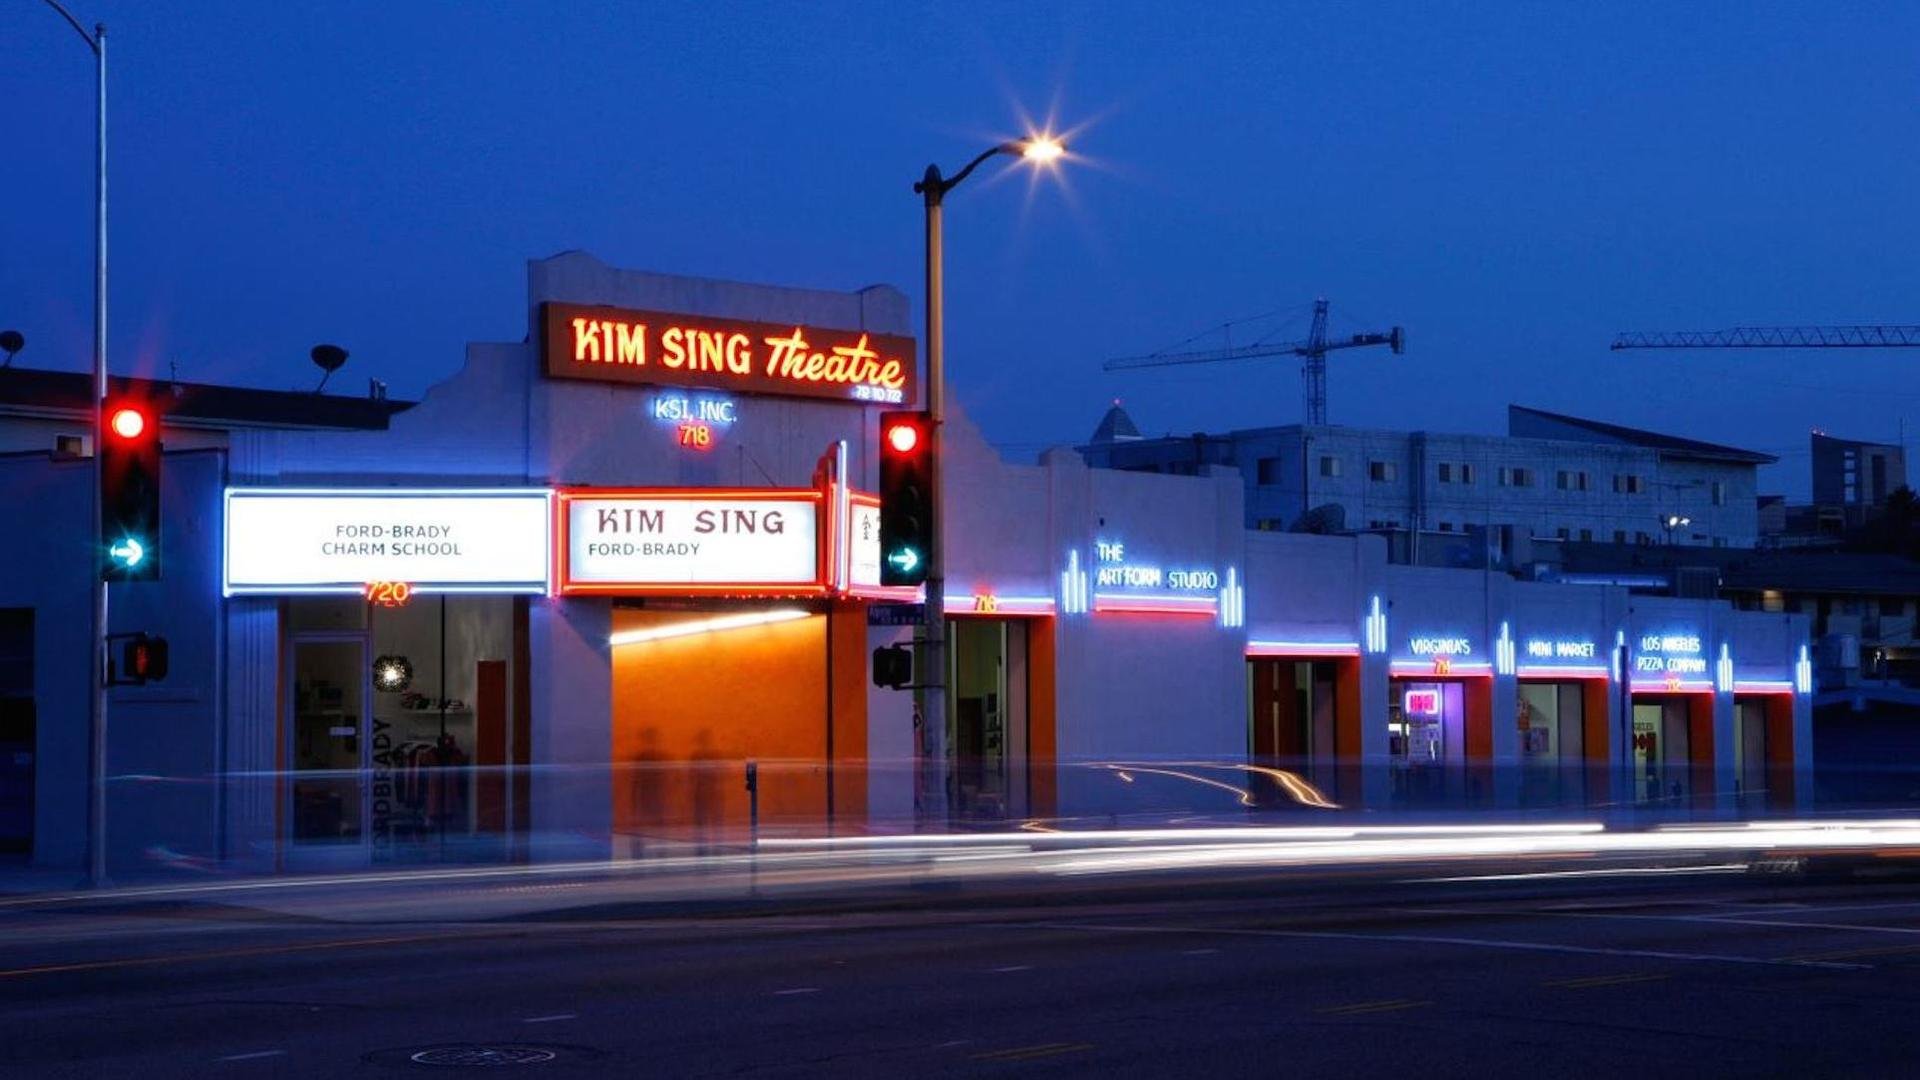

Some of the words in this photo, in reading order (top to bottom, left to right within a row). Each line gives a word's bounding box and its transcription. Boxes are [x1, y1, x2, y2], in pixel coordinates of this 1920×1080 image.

[573, 317, 646, 365] KIM
[662, 326, 751, 374] SING
[765, 328, 905, 389] Theatre
[656, 399, 694, 422] KSI,
[699, 400, 738, 422] INC.
[680, 425, 711, 446] 718
[598, 508, 665, 534] KIM
[694, 509, 785, 535] SING
[336, 525, 451, 538] FORD-BRADY
[321, 542, 385, 556] CHARM
[391, 542, 462, 556] SCHOOL
[588, 542, 700, 556] FORD-BRADY
[1097, 543, 1124, 562] THE
[1168, 571, 1218, 589] STUDIO
[367, 580, 409, 602] 720
[1410, 638, 1471, 655] VIRGINIA'S
[1528, 640, 1552, 657] MINI
[1556, 641, 1595, 657] MARKET
[1642, 636, 1661, 651] LOS
[1662, 637, 1701, 652] ANGELES
[1637, 656, 1664, 671] PIZZA
[1666, 658, 1707, 673] COMPANY
